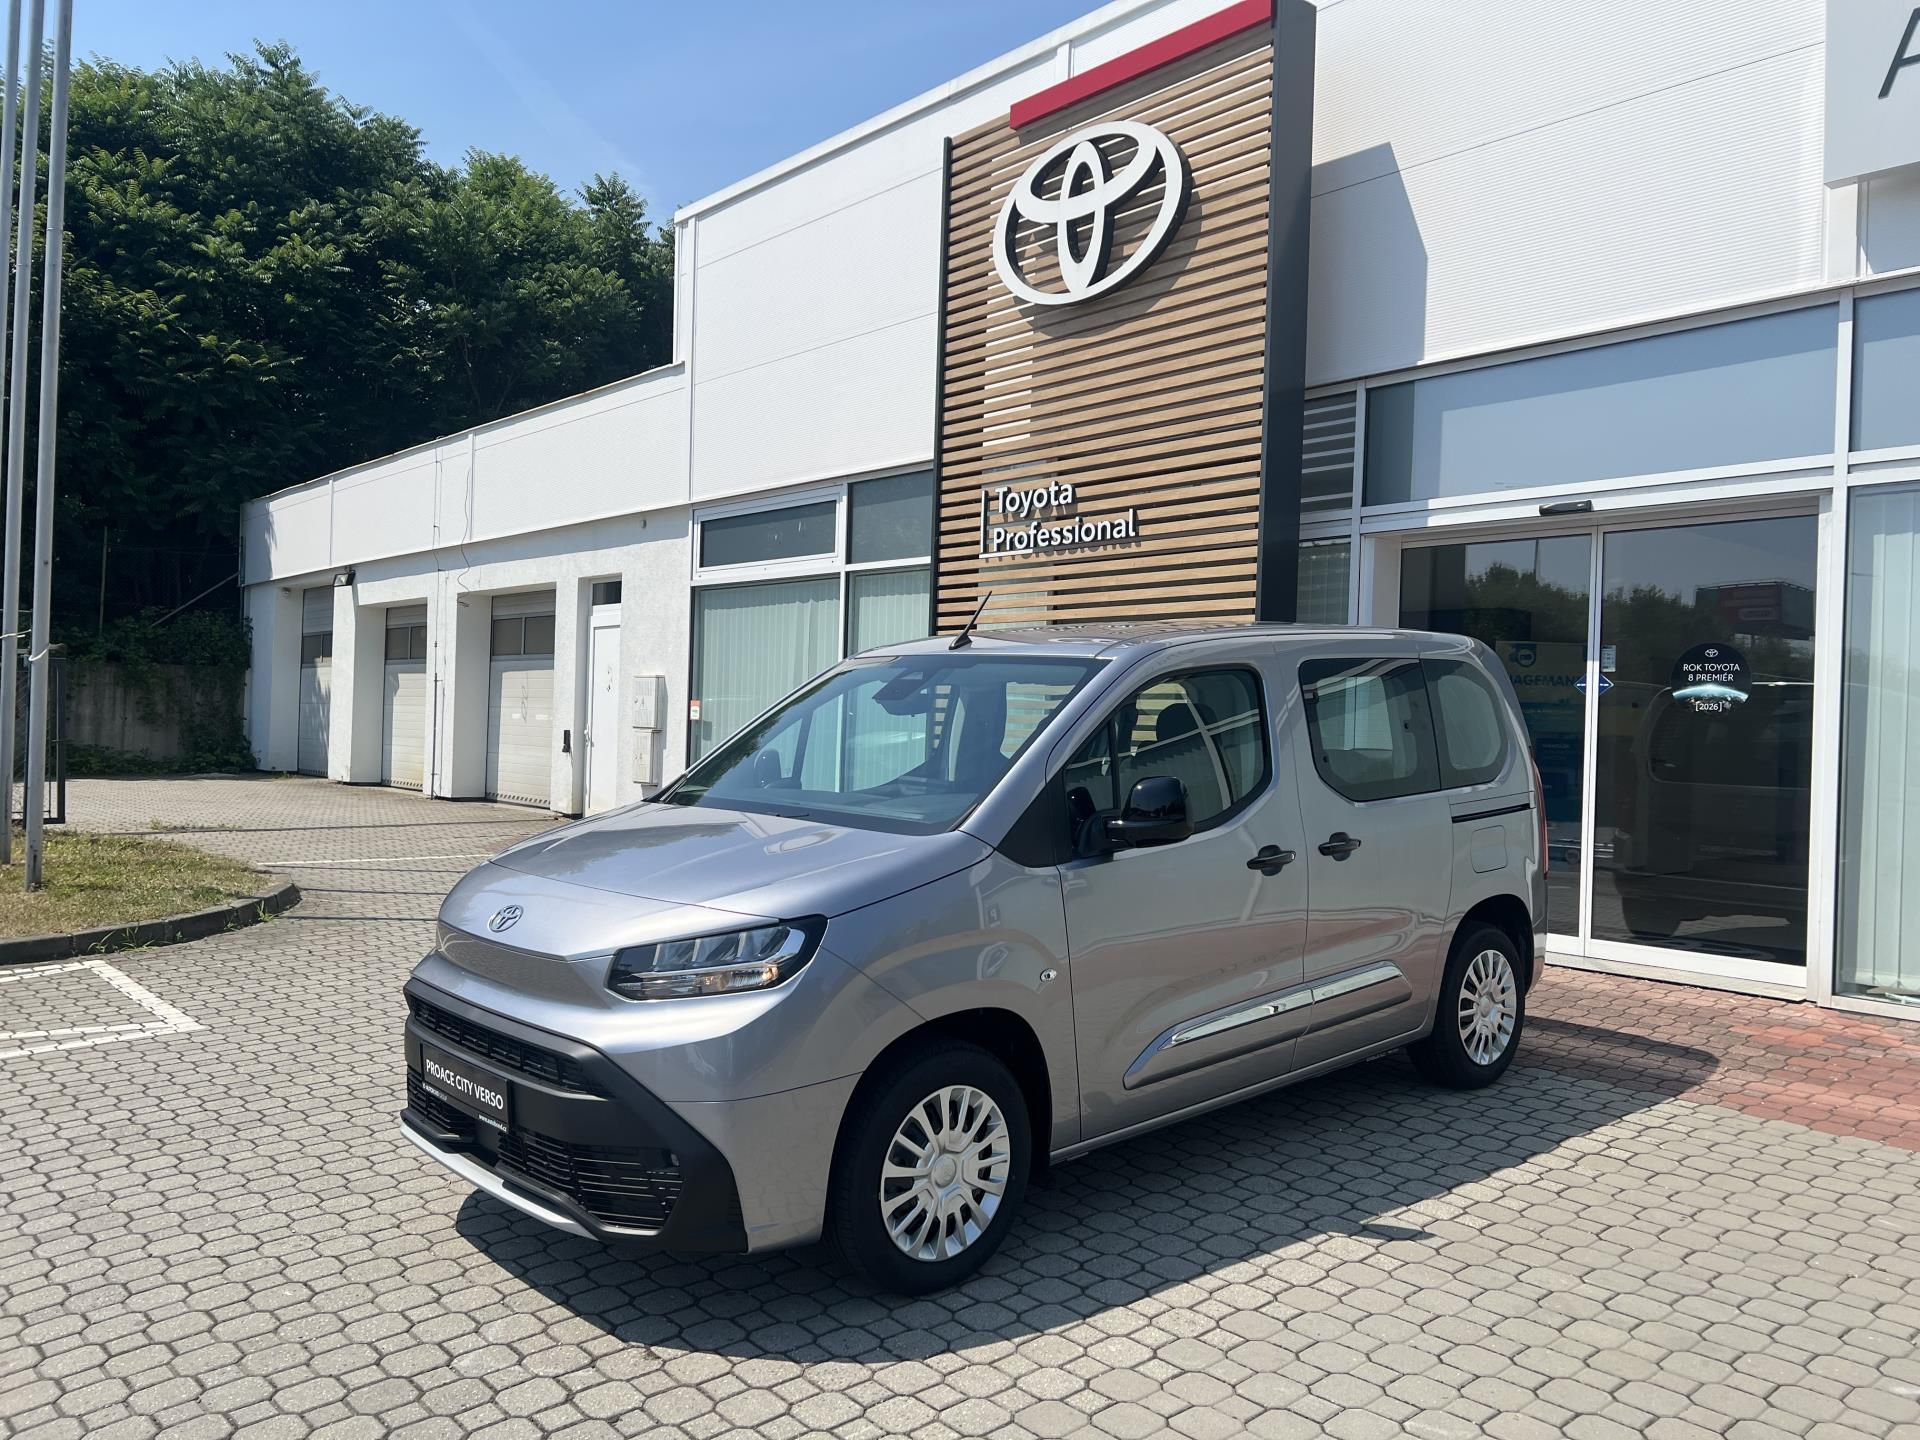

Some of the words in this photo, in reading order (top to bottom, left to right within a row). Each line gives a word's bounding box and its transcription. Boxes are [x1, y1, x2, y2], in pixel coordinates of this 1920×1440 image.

[995, 481, 1073, 518] Toyota
[993, 508, 1136, 552] Professional
[1683, 663, 1702, 671] ROK
[1704, 663, 1740, 671] TOYOTA
[1688, 673, 1694, 682] 8
[1696, 672, 1734, 682] PREMIÉR
[426, 1059, 455, 1087] PROACE
[455, 1075, 473, 1096] CITY
[474, 1083, 504, 1110] VERSO
